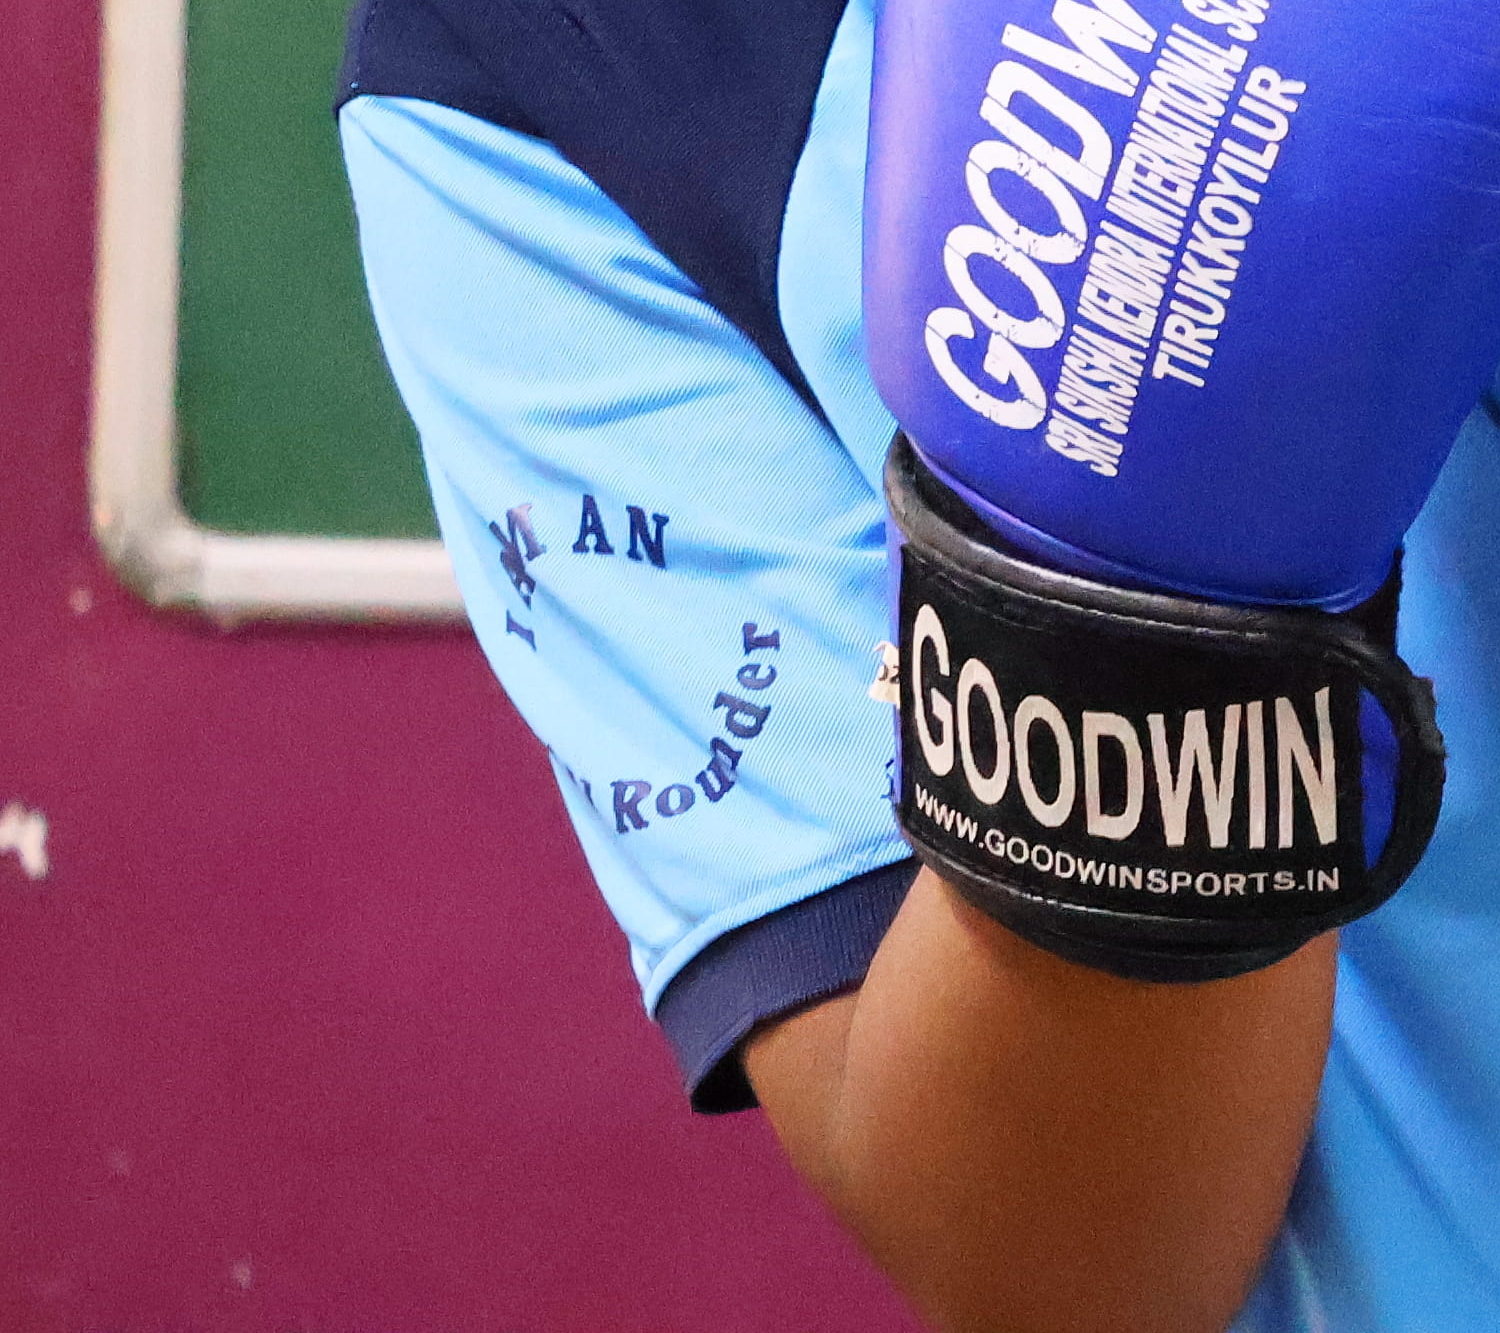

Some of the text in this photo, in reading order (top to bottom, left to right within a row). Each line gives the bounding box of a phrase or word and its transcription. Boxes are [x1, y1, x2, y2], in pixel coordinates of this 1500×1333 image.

[1102, 22, 1250, 244] INTERNATIONAL
[1077, 226, 1178, 346] KENDRA
[1152, 63, 1306, 389] TIRUKKOYILUR
[1054, 323, 1152, 431] SIKSHA
[1043, 418, 1123, 477] SRI
[911, 604, 1338, 850] GOODWIN
[914, 783, 1341, 897] WWW.GOODWINSPORTS.IN
